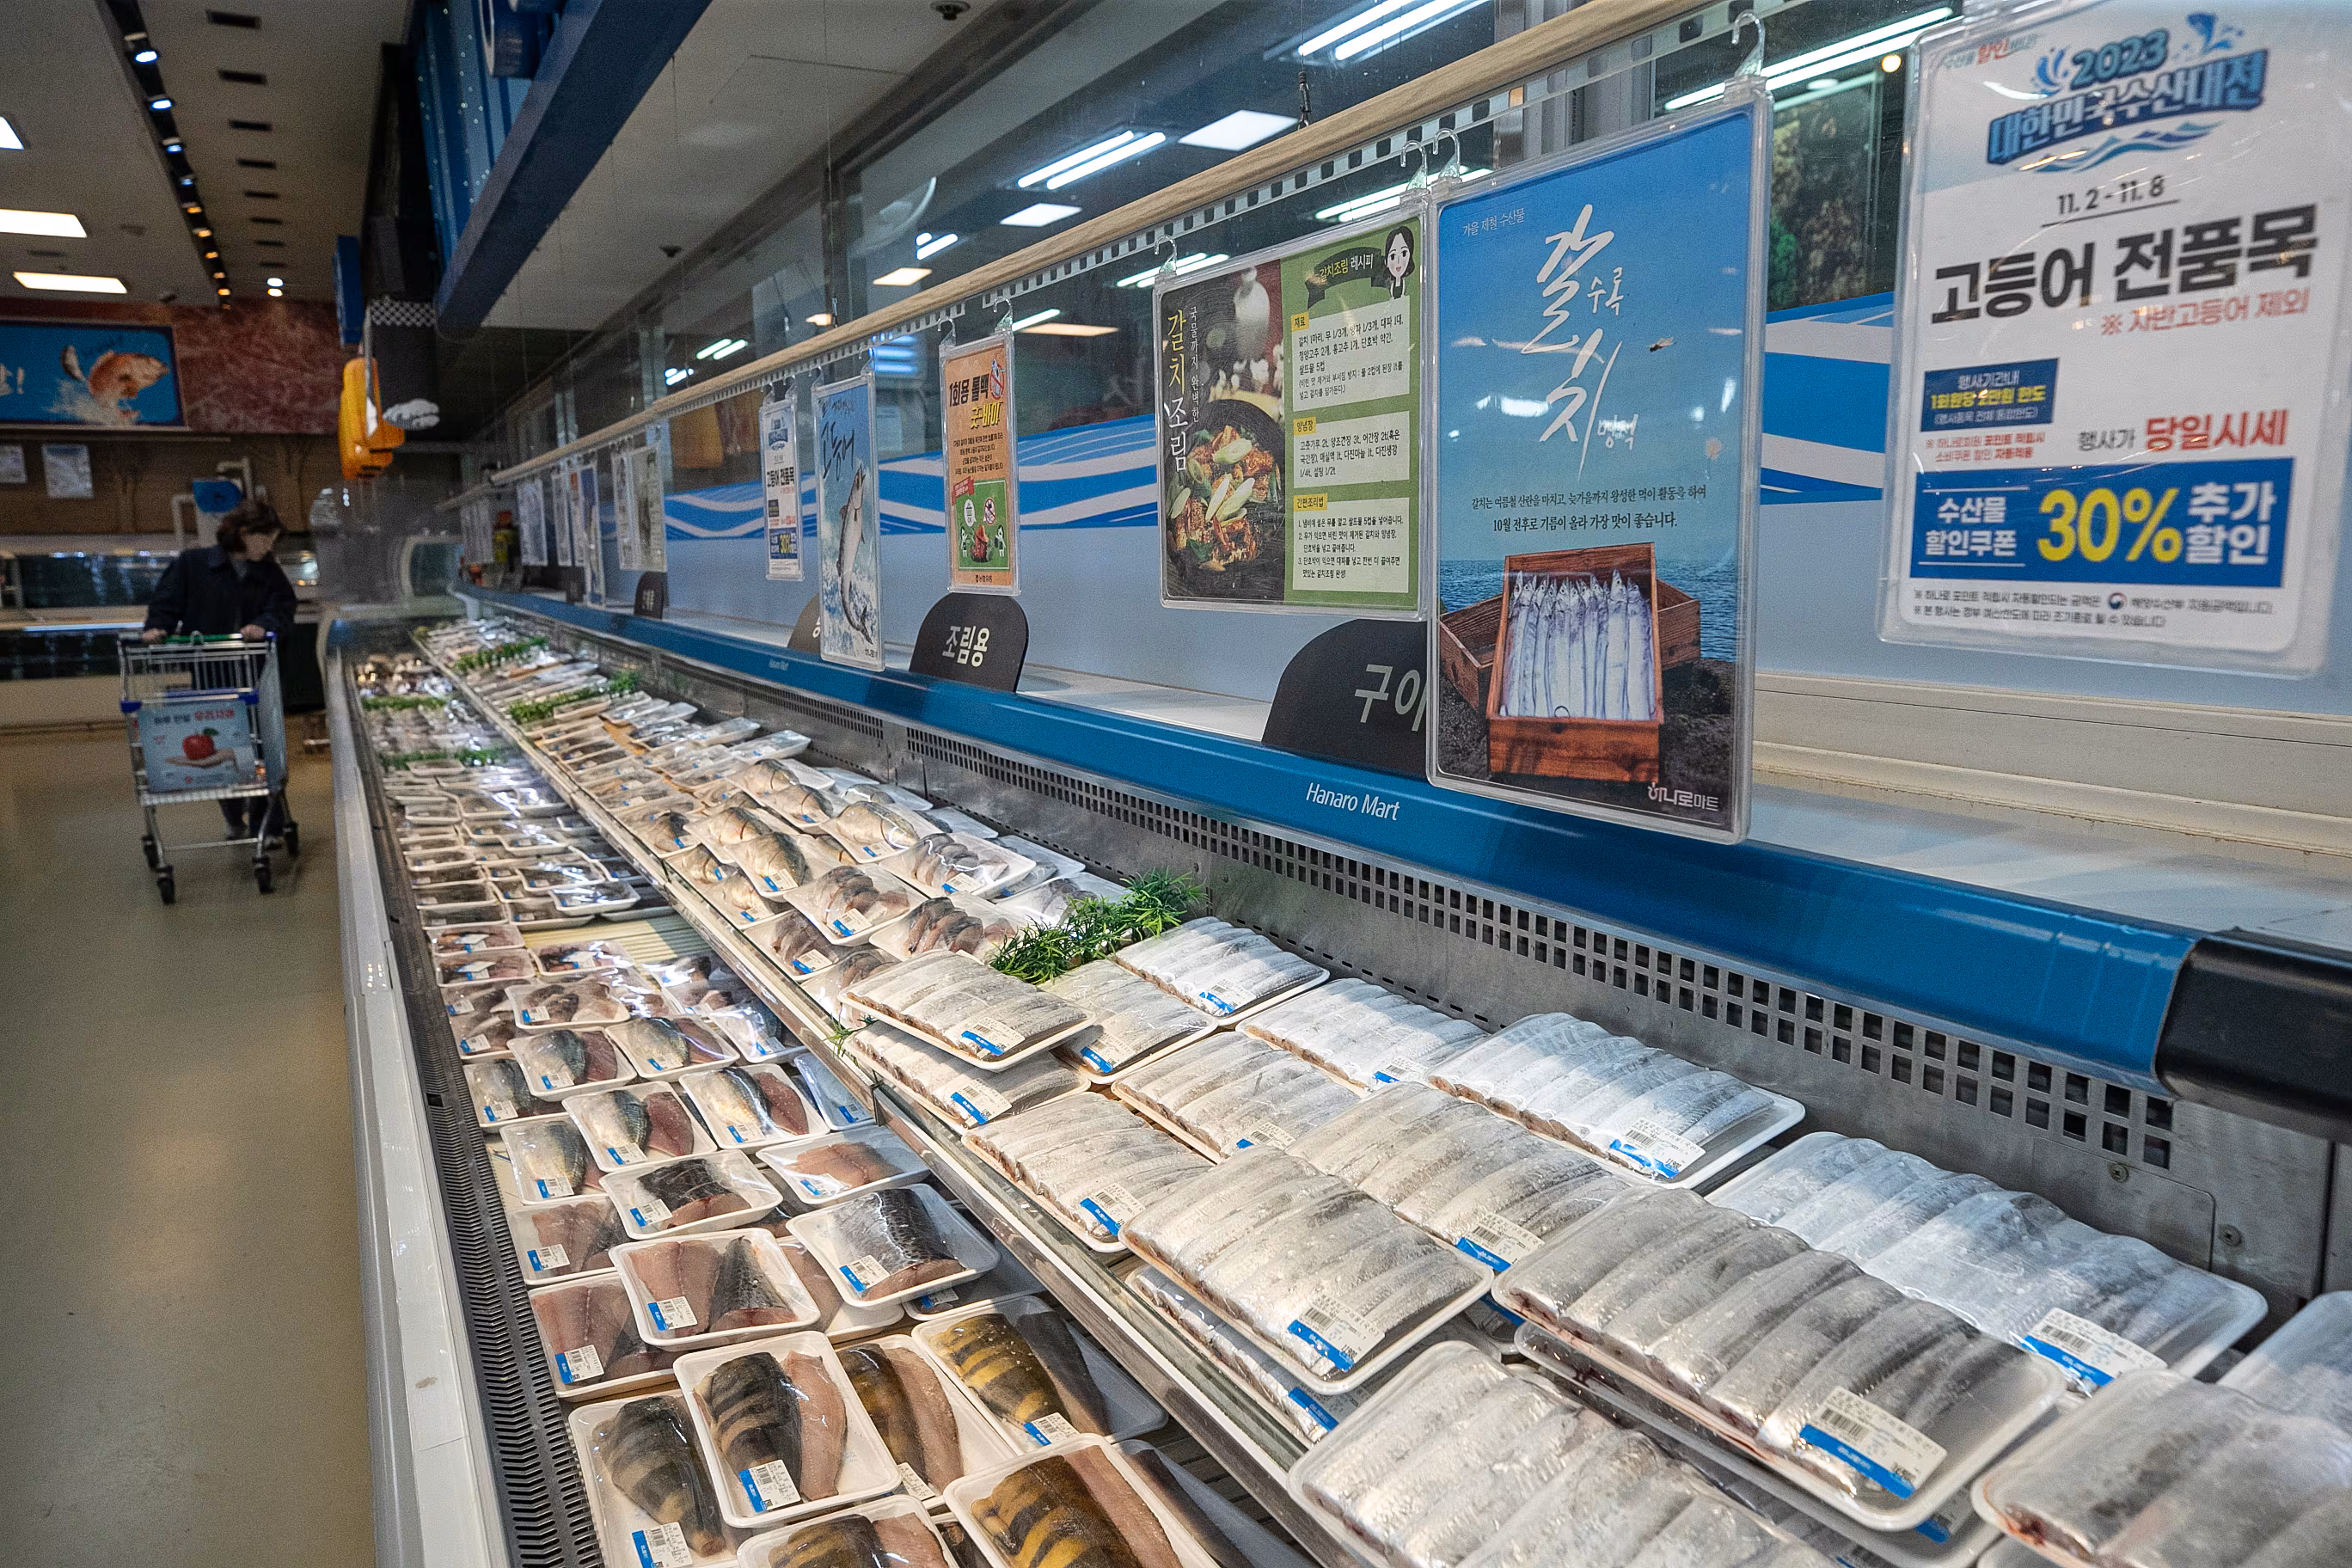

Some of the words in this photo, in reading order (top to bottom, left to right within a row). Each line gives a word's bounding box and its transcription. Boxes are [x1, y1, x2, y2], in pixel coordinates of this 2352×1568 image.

[2071, 28, 2171, 88] 2023
[1462, 221, 1479, 237] 가을
[1480, 215, 1498, 232] 제철
[1499, 207, 1525, 227] 수산물
[1320, 257, 1349, 283] 갈치조림
[1350, 253, 1375, 271] 레시피
[1931, 242, 2095, 324] 고등어
[2114, 203, 2319, 303] 전품목
[1294, 316, 1306, 328] 재료
[1381, 316, 1393, 329] 대파
[2127, 295, 2250, 333] 자반고등어
[2255, 286, 2312, 317] 제외
[1361, 335, 1378, 349] 단호박
[1316, 361, 1326, 372] 5컵
[949, 378, 971, 407] 1회용
[971, 373, 990, 402] 롤백
[1296, 420, 1314, 432] 양념장
[1363, 432, 1380, 444] 어간장
[2076, 427, 2136, 452] 행사가
[2145, 407, 2289, 453] 당일시세
[1296, 496, 1325, 509] 간편조리법
[1472, 496, 1493, 511] 갈치는
[1494, 494, 1517, 509] 여름철
[1517, 493, 1540, 508] 산란을
[1568, 491, 1608, 505] 늦가을까지
[1609, 488, 1637, 504] 왕성한
[1638, 487, 1656, 503] 먹이
[1657, 486, 1686, 501] 활동을
[1687, 484, 1707, 499] 하여
[1937, 495, 2007, 524] 수산물
[2188, 481, 2276, 523] 추가
[1492, 518, 1511, 533] 10월
[1512, 517, 1540, 532] 전후로
[1540, 515, 1567, 531] 기름이
[1568, 514, 1589, 530] 올라
[1589, 513, 1610, 530] 가장
[1611, 512, 1632, 530] 맛이
[1633, 511, 1678, 529] 좋습니다.
[2036, 487, 2183, 563] 30%
[1924, 528, 2018, 558] 할인쿠폰
[2184, 523, 2269, 566] 할인
[941, 625, 990, 667] 조림용
[1306, 781, 1358, 812] Hanaro
[1361, 793, 1400, 821] Mart
[1647, 781, 1719, 812] 하나로마트
